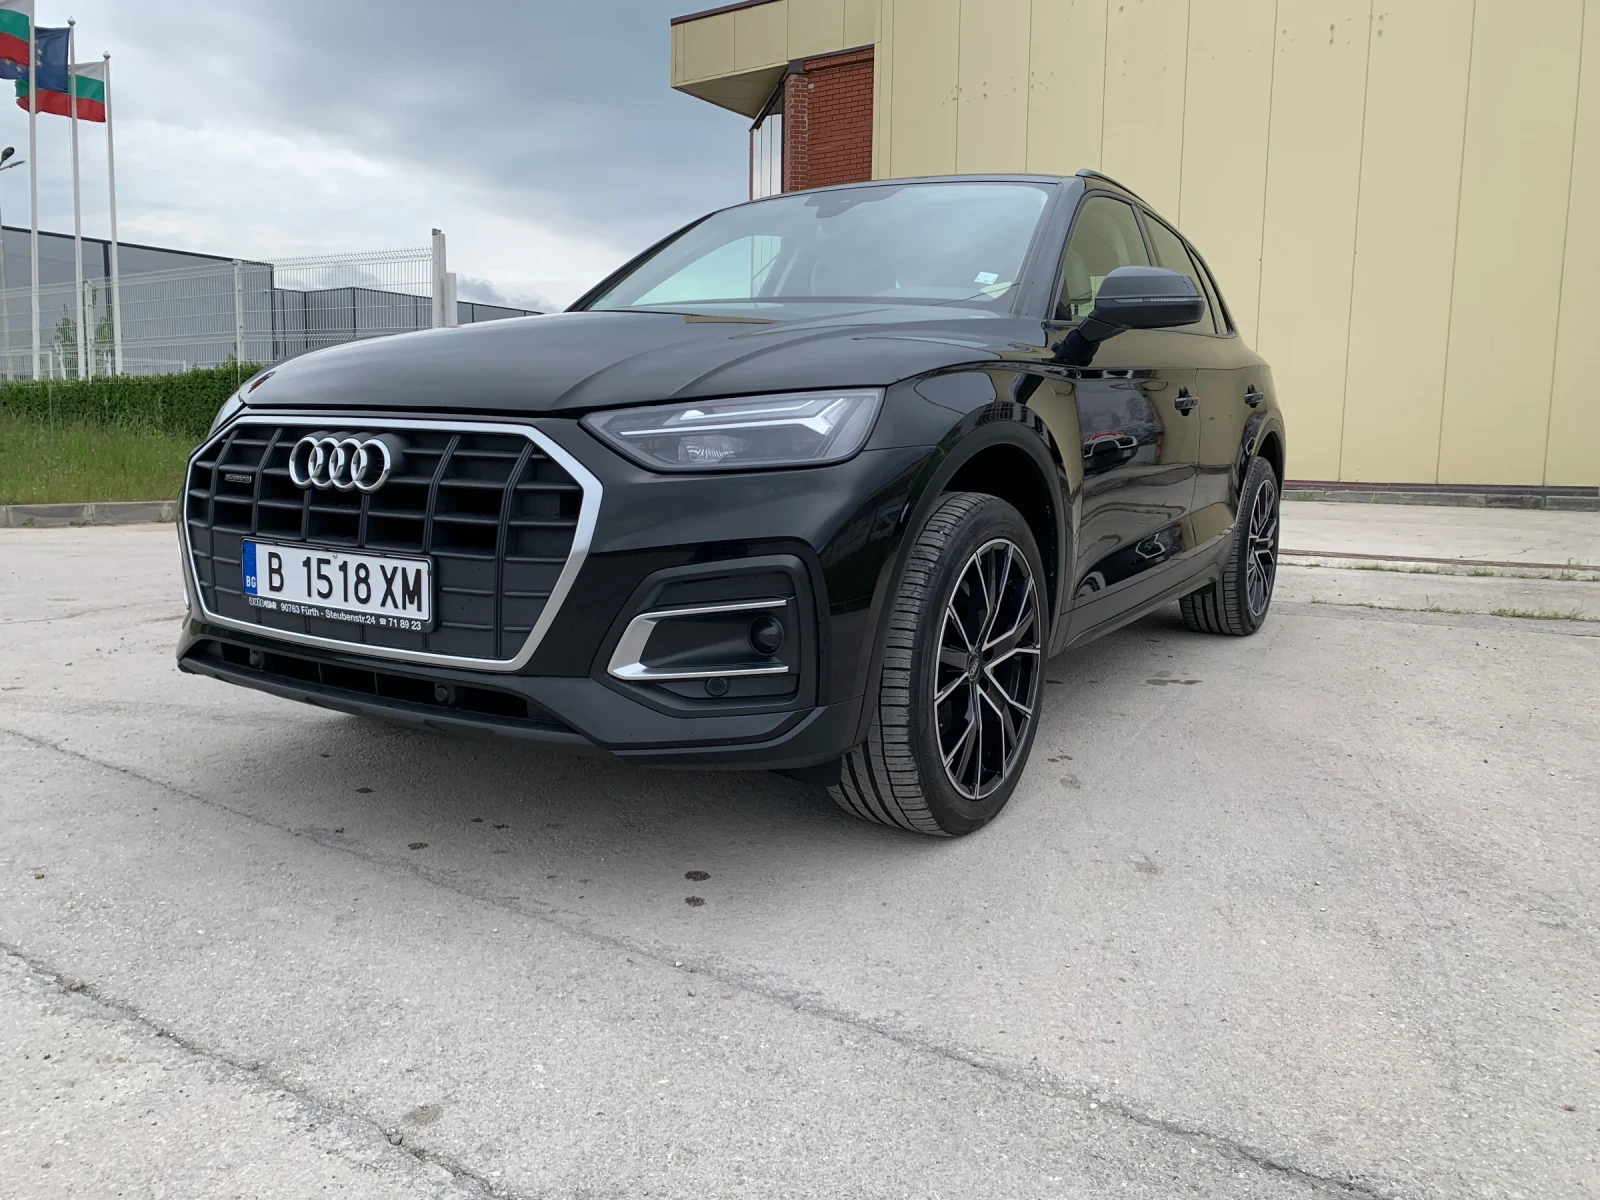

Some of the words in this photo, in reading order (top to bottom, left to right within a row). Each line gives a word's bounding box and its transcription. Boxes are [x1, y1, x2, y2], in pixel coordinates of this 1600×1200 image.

[245, 575, 257, 588] BG
[268, 551, 284, 593] B
[302, 556, 372, 605] 1518
[380, 564, 422, 613] XM
[280, 603, 300, 614] 90763
[301, 605, 319, 617] Fürth
[325, 609, 376, 625] Steubenstr.24
[388, 618, 397, 627] 71
[400, 619, 410, 629] 89
[411, 621, 422, 630] 23
